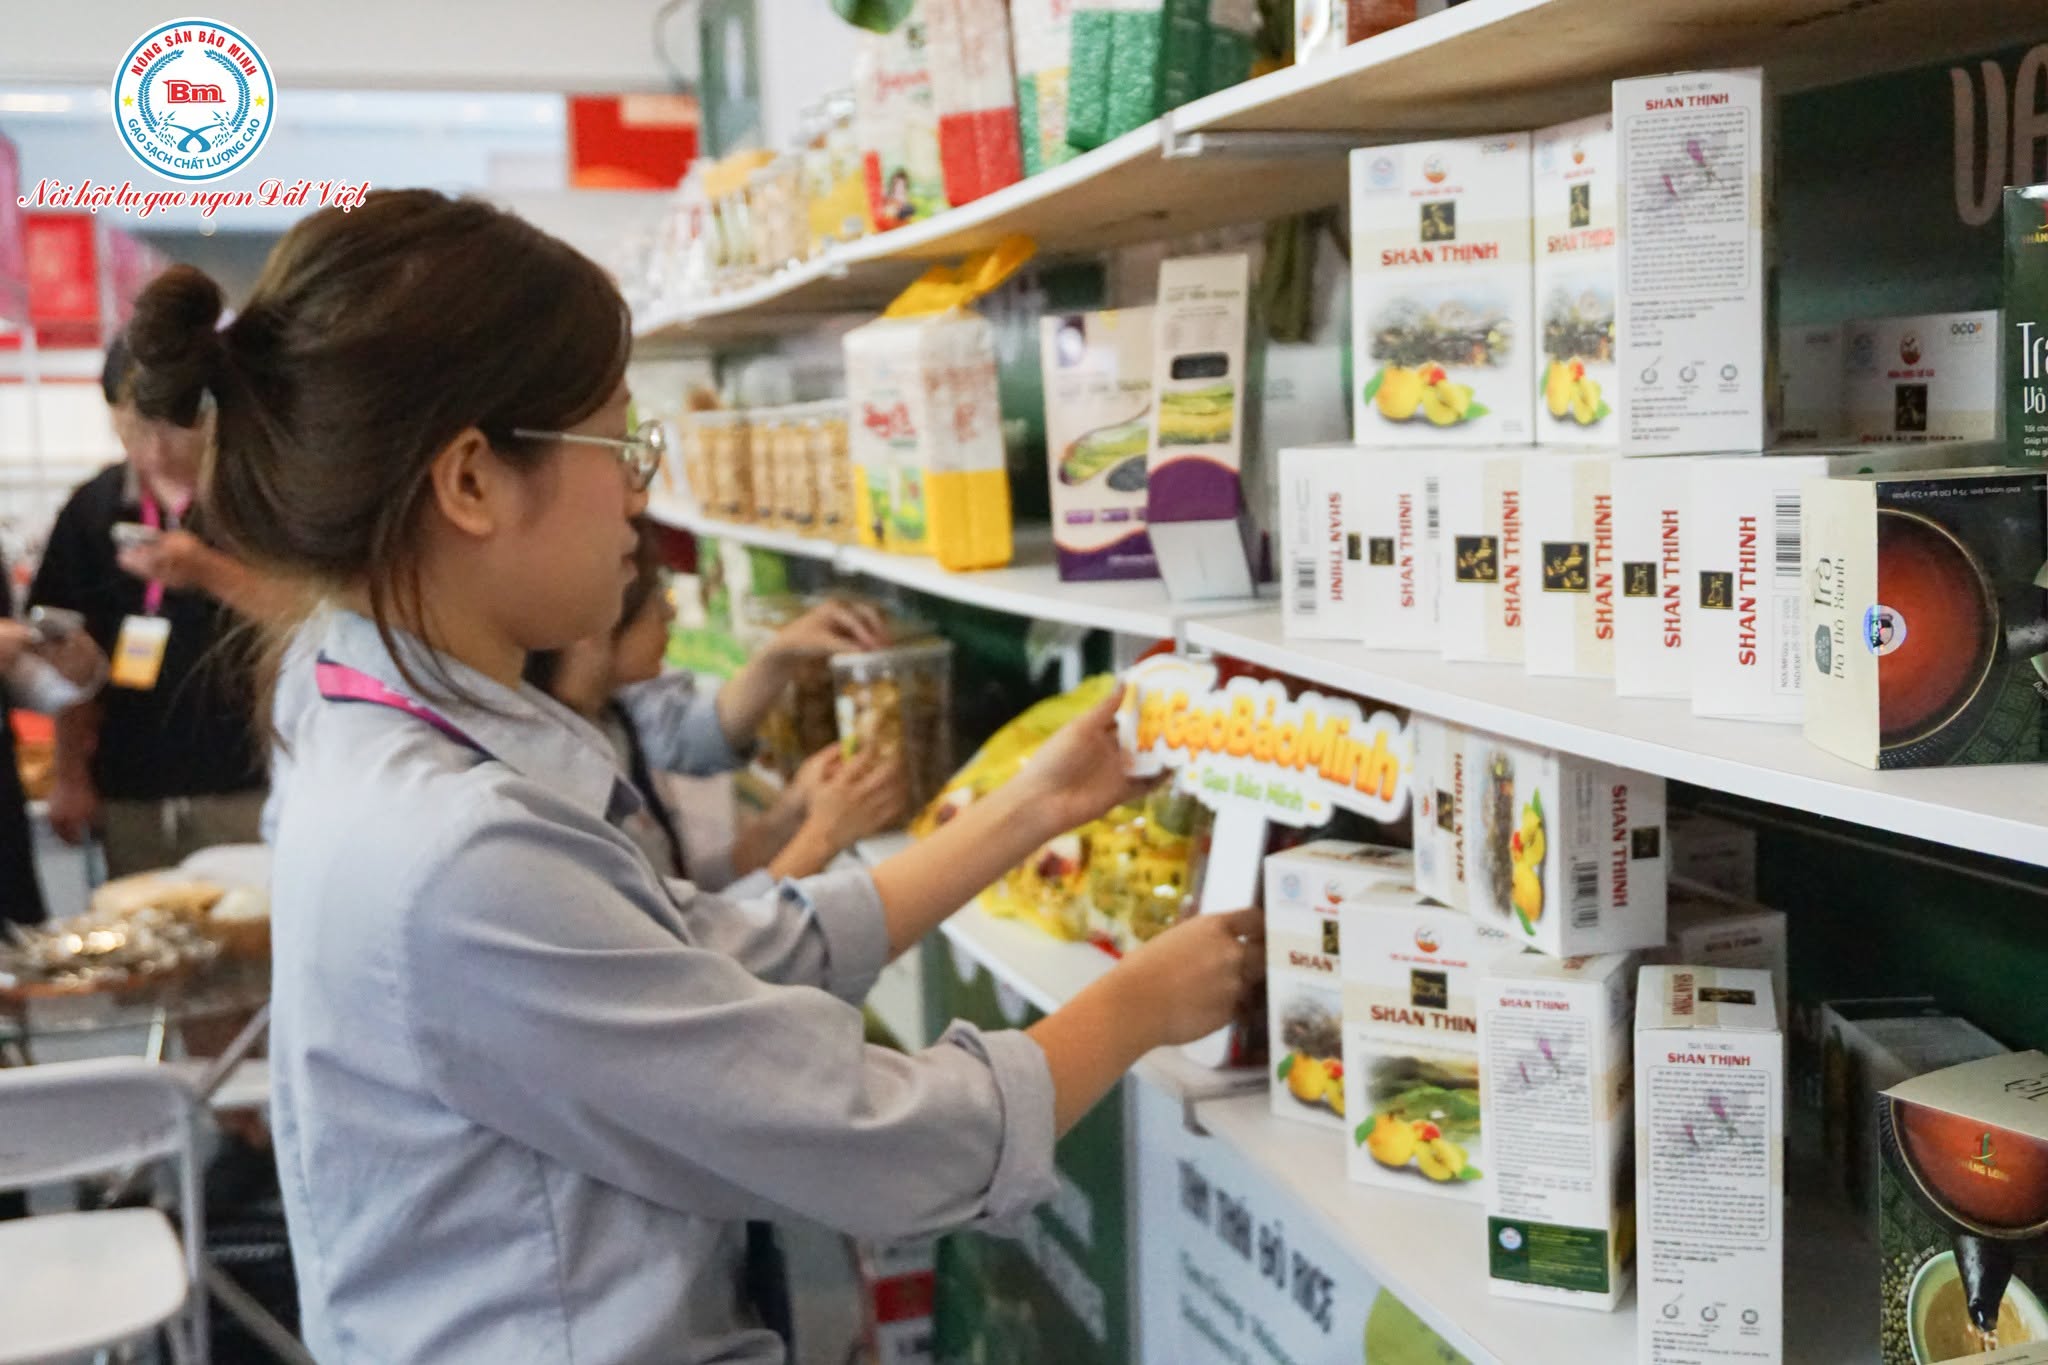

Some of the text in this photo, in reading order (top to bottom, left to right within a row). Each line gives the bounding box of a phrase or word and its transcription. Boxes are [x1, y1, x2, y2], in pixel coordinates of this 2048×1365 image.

[1645, 97, 1684, 111] SHAN
[1381, 246, 1434, 267] SHAN
[2016, 322, 2048, 379] Tr
[1329, 492, 1342, 541] SHAN
[1400, 556, 1414, 608] SHAN
[1504, 564, 1521, 627] SHAN
[1596, 574, 1614, 640] SHAN
[1664, 584, 1681, 648] SHAN
[1738, 597, 1756, 666] SHAN
[1611, 784, 1628, 843] SHAN
[1288, 950, 1333, 972] SHAN
[1371, 1004, 1425, 1028] SHAN
[1667, 1052, 1706, 1065] SHAN
